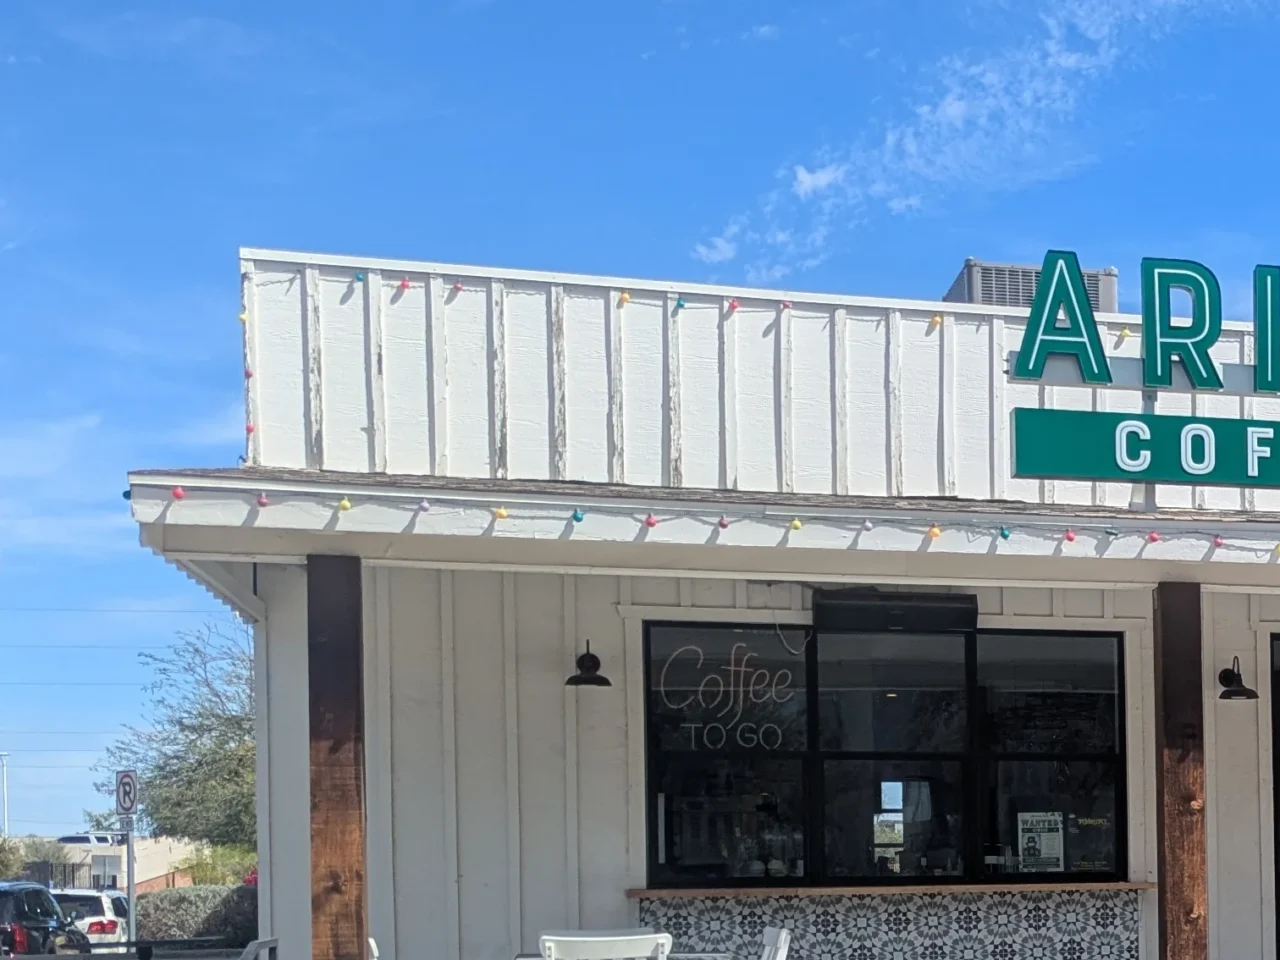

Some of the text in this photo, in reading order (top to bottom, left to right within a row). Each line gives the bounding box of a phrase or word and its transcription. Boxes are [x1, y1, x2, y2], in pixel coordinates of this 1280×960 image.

[661, 643, 794, 730] Coffee
[681, 723, 782, 751] TO GO
[1021, 819, 1059, 827] WANTED
